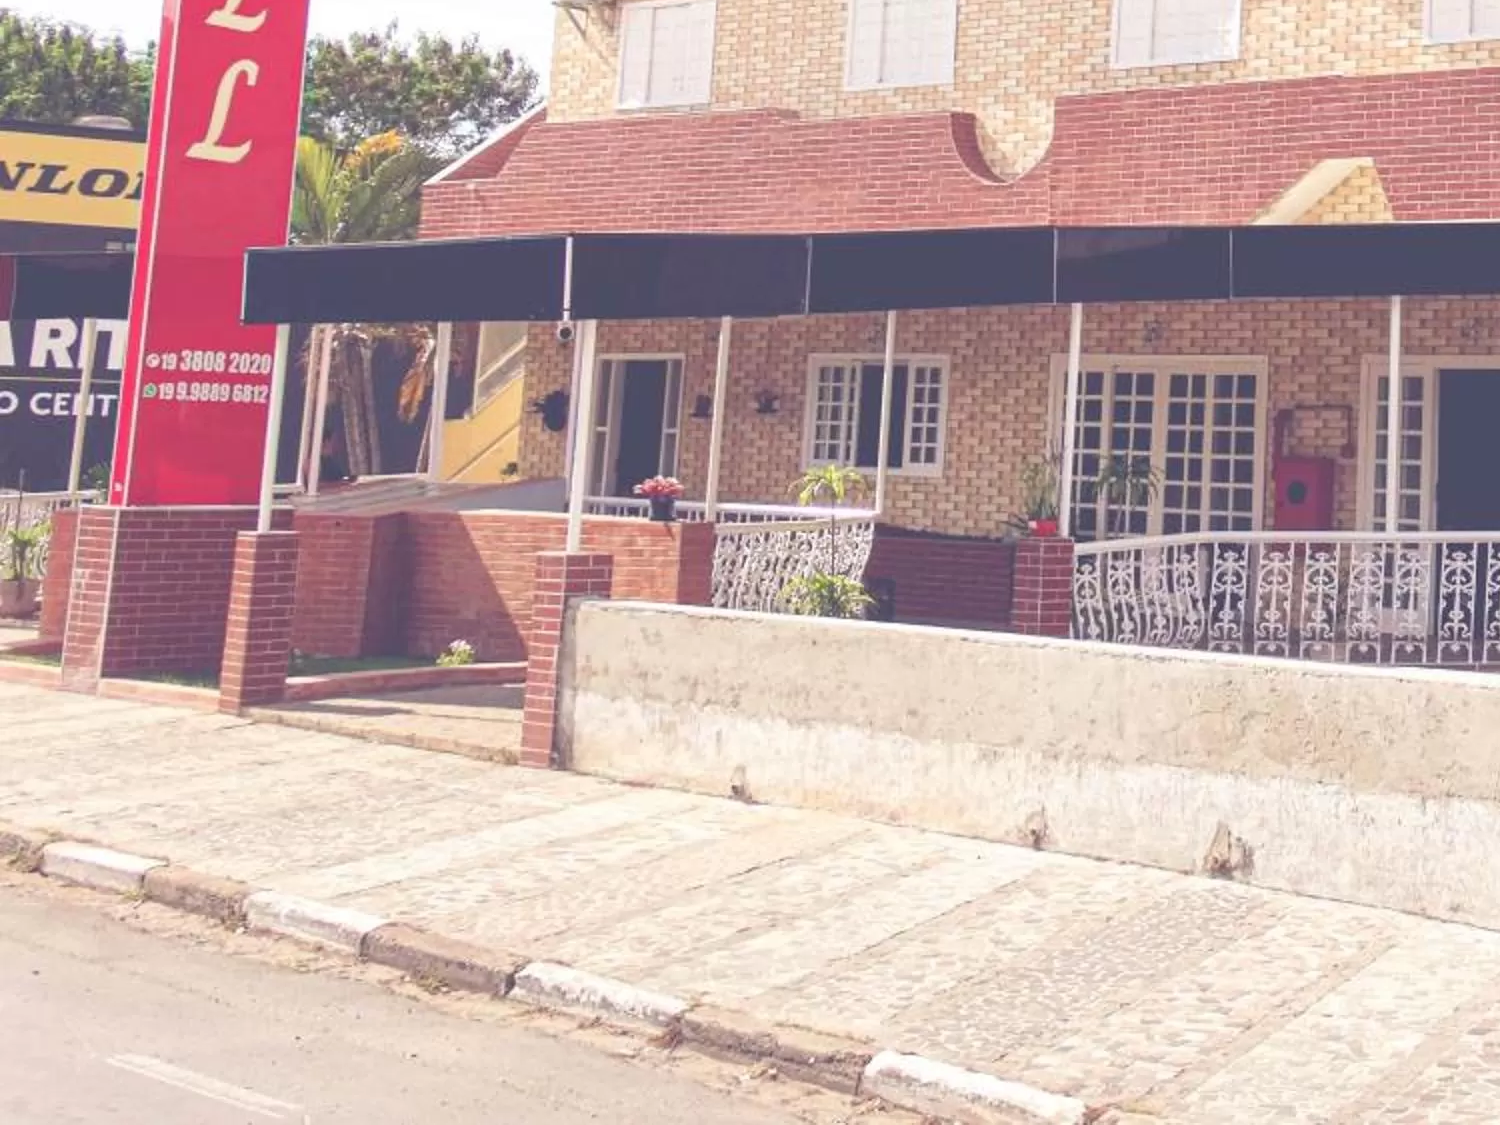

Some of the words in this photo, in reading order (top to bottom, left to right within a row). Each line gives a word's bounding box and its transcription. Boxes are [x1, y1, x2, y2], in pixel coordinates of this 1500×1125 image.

[160, 352, 177, 370] 19
[227, 352, 272, 375] 2020
[158, 382, 175, 401] 19
